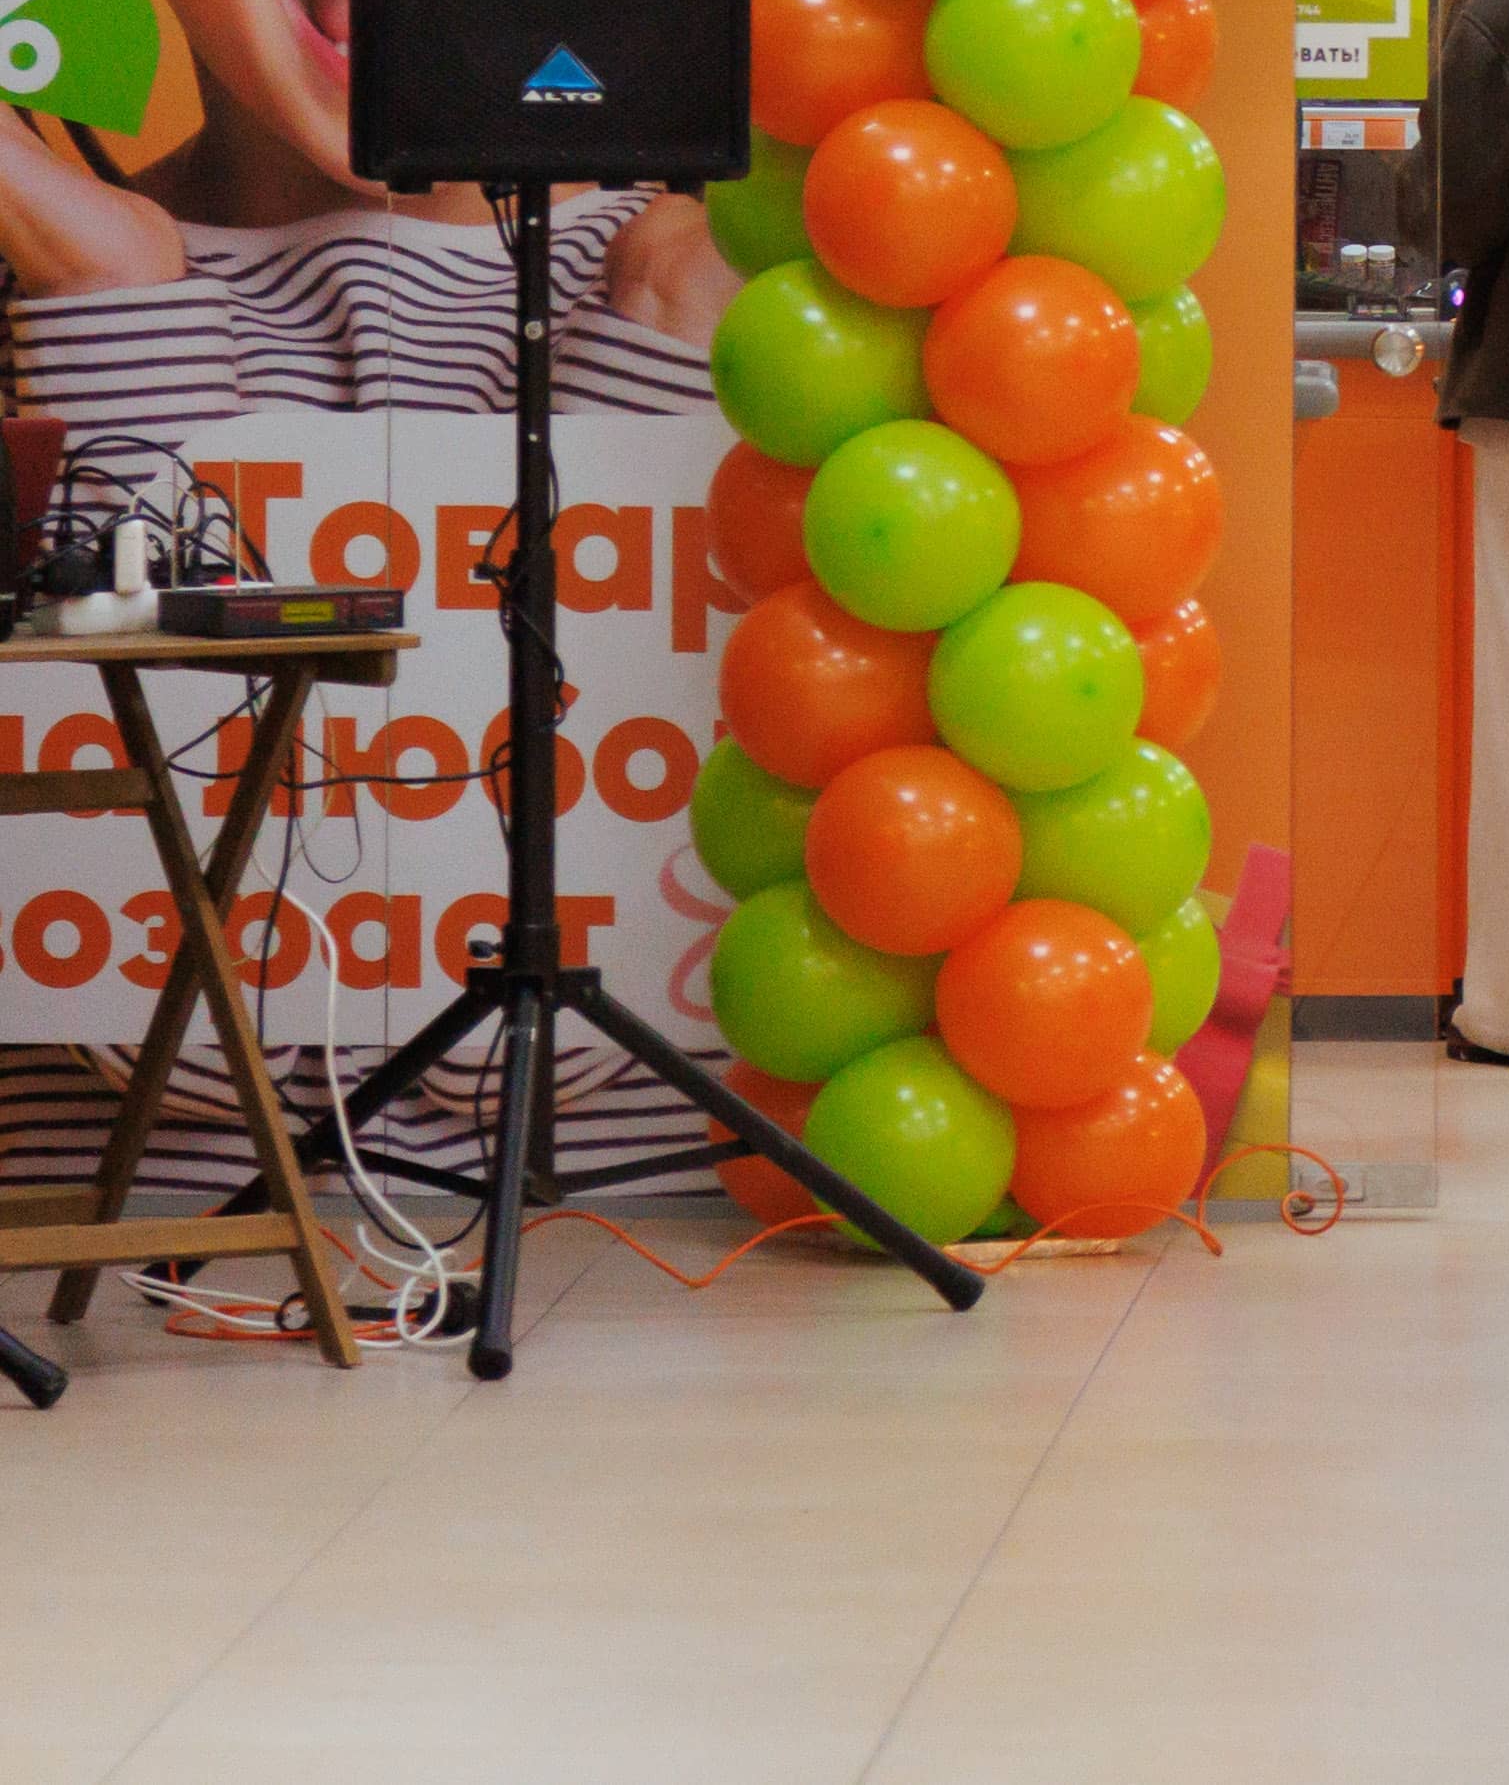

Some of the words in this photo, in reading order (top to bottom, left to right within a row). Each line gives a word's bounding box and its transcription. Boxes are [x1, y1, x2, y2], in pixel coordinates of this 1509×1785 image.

[1296, 47, 1360, 63] ВАТЬ!
[521, 89, 603, 102] ALTO
[0, 889, 615, 1022] озраст
